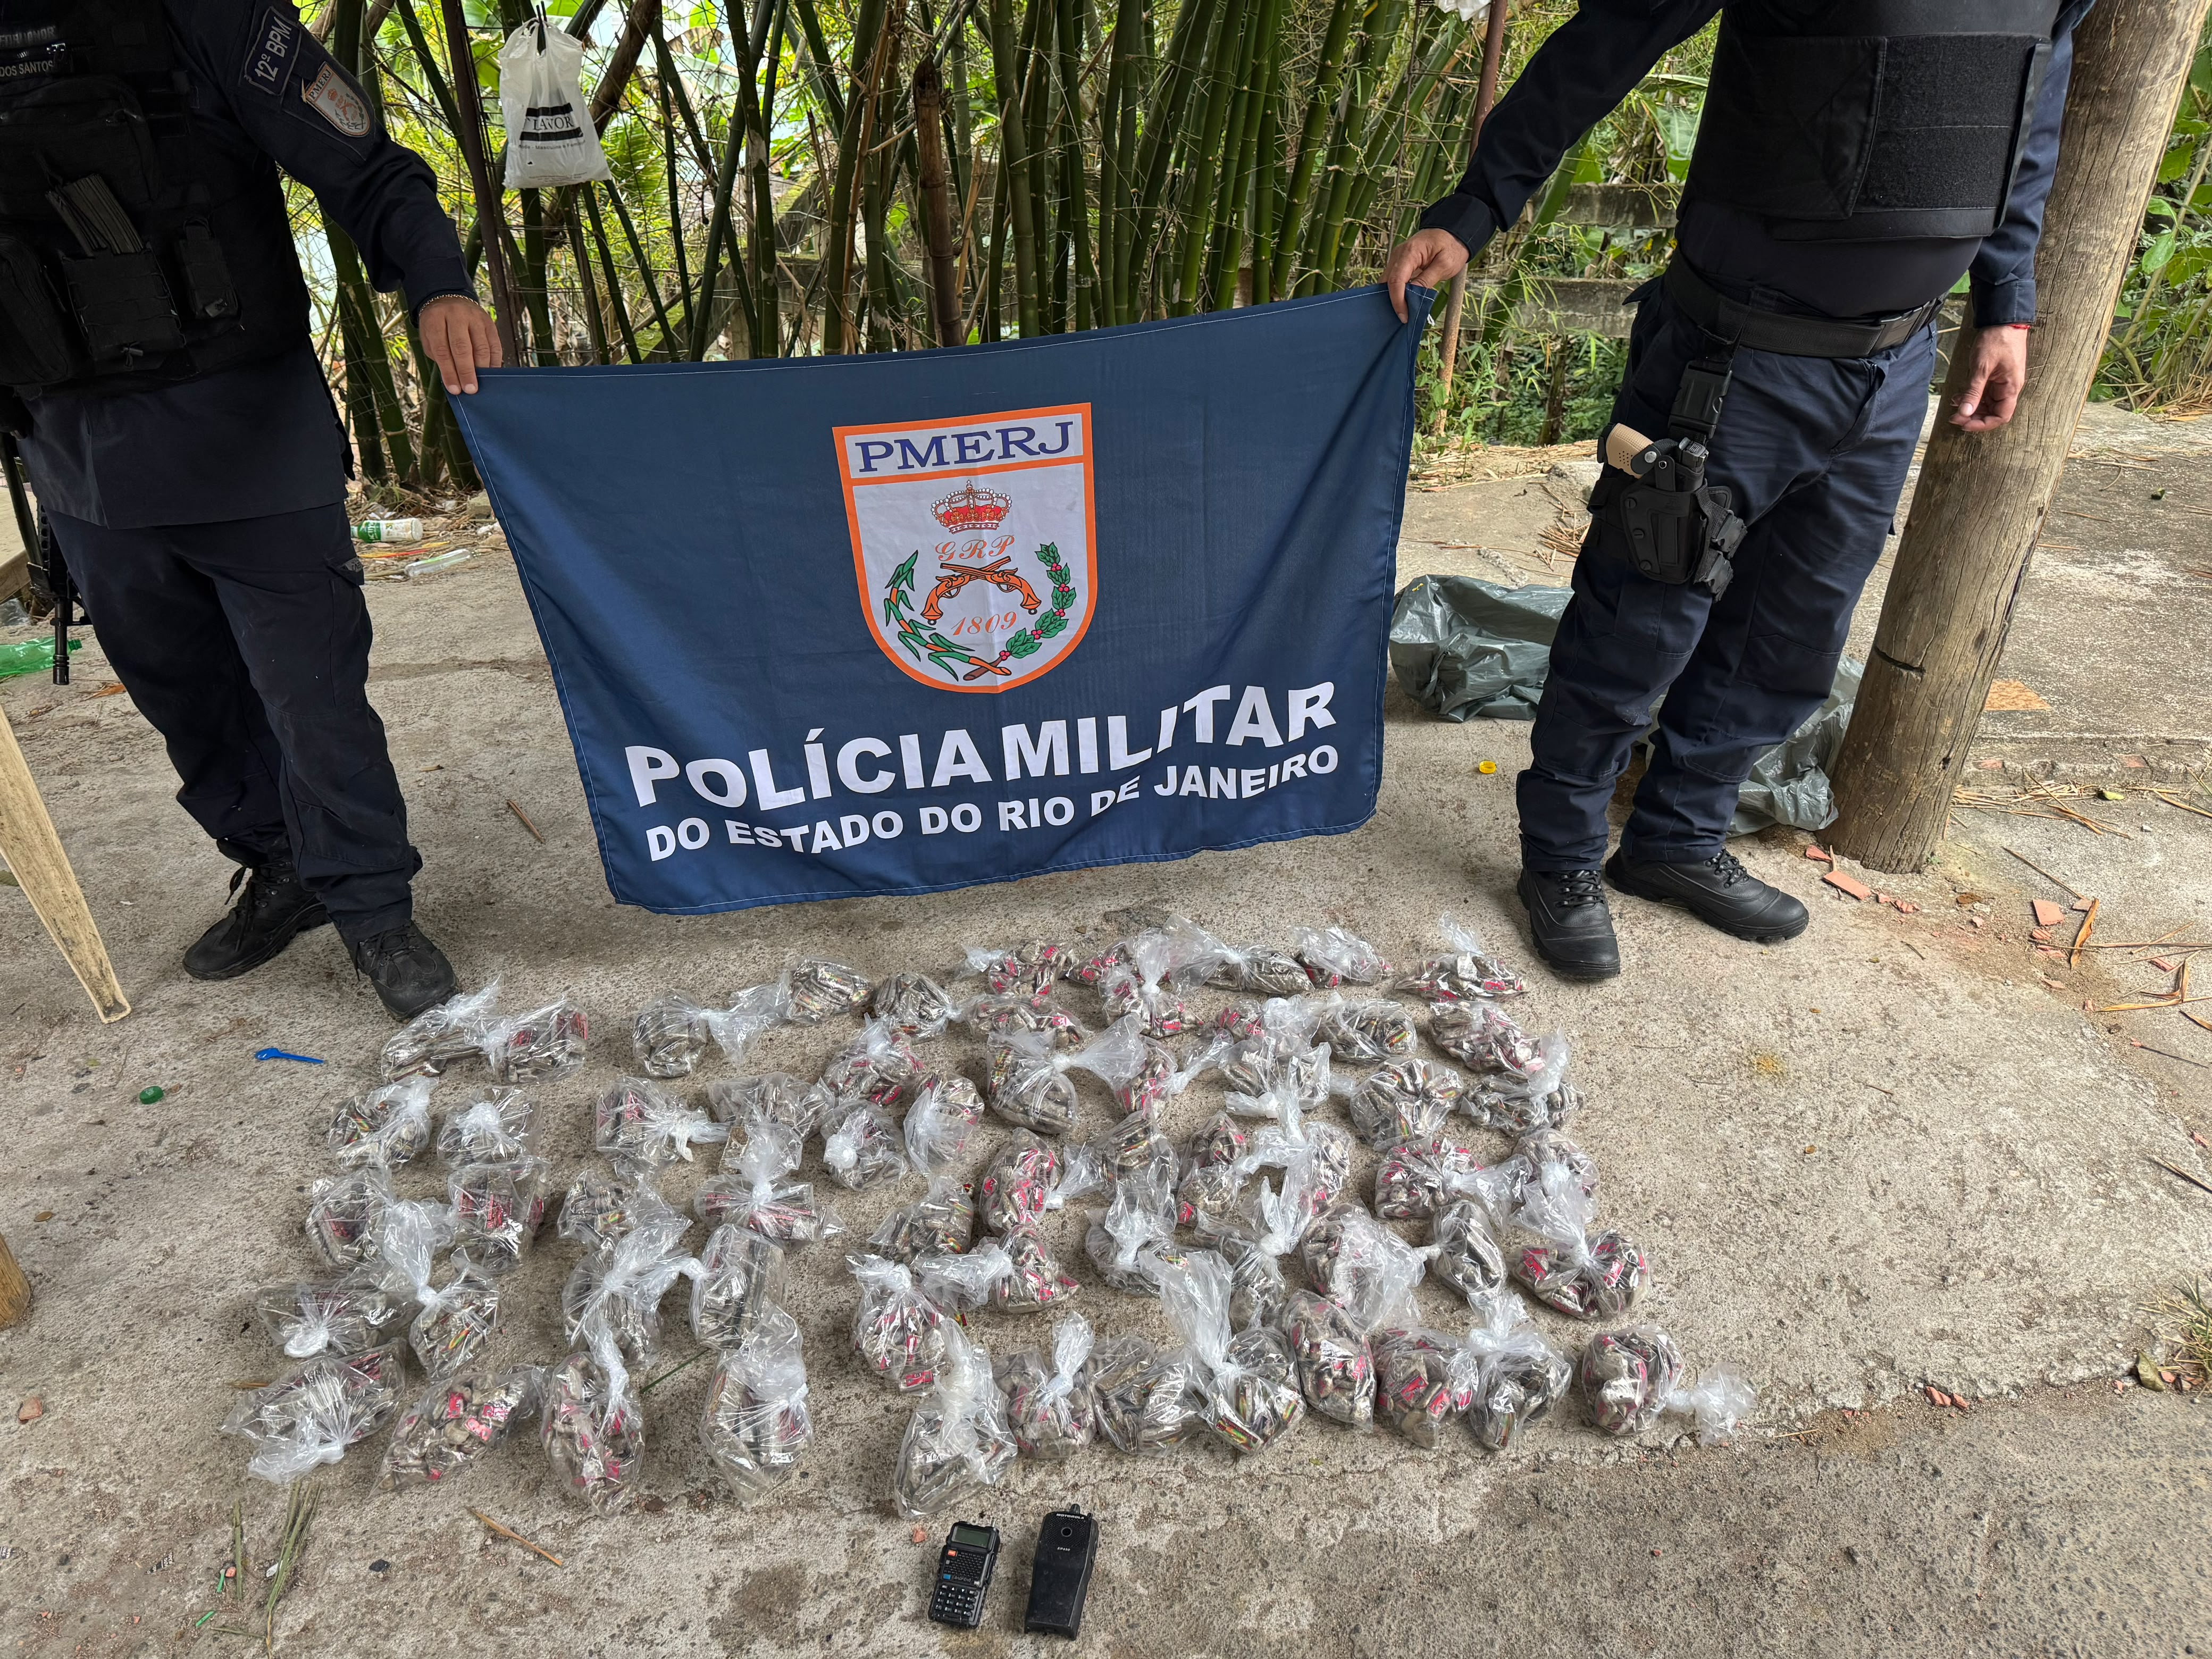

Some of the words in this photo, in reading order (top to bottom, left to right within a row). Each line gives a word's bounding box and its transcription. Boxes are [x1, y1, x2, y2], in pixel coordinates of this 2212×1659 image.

[265, 16, 292, 58] BPM
[19, 60, 55, 75] SANTOS
[308, 69, 332, 99] PMERJ
[854, 421, 1074, 473] PMERJ
[934, 534, 1015, 562] GRP
[952, 611, 1017, 635] 1809
[625, 727, 993, 811] POLÍCIA
[1001, 681, 1337, 781] MILITAR
[646, 817, 710, 862] DO
[724, 810, 903, 854] ESTADO
[919, 803, 982, 835] DO
[998, 797, 1075, 831] RIO
[1091, 775, 1140, 817] DE
[1153, 744, 1338, 799] JANEIRO
